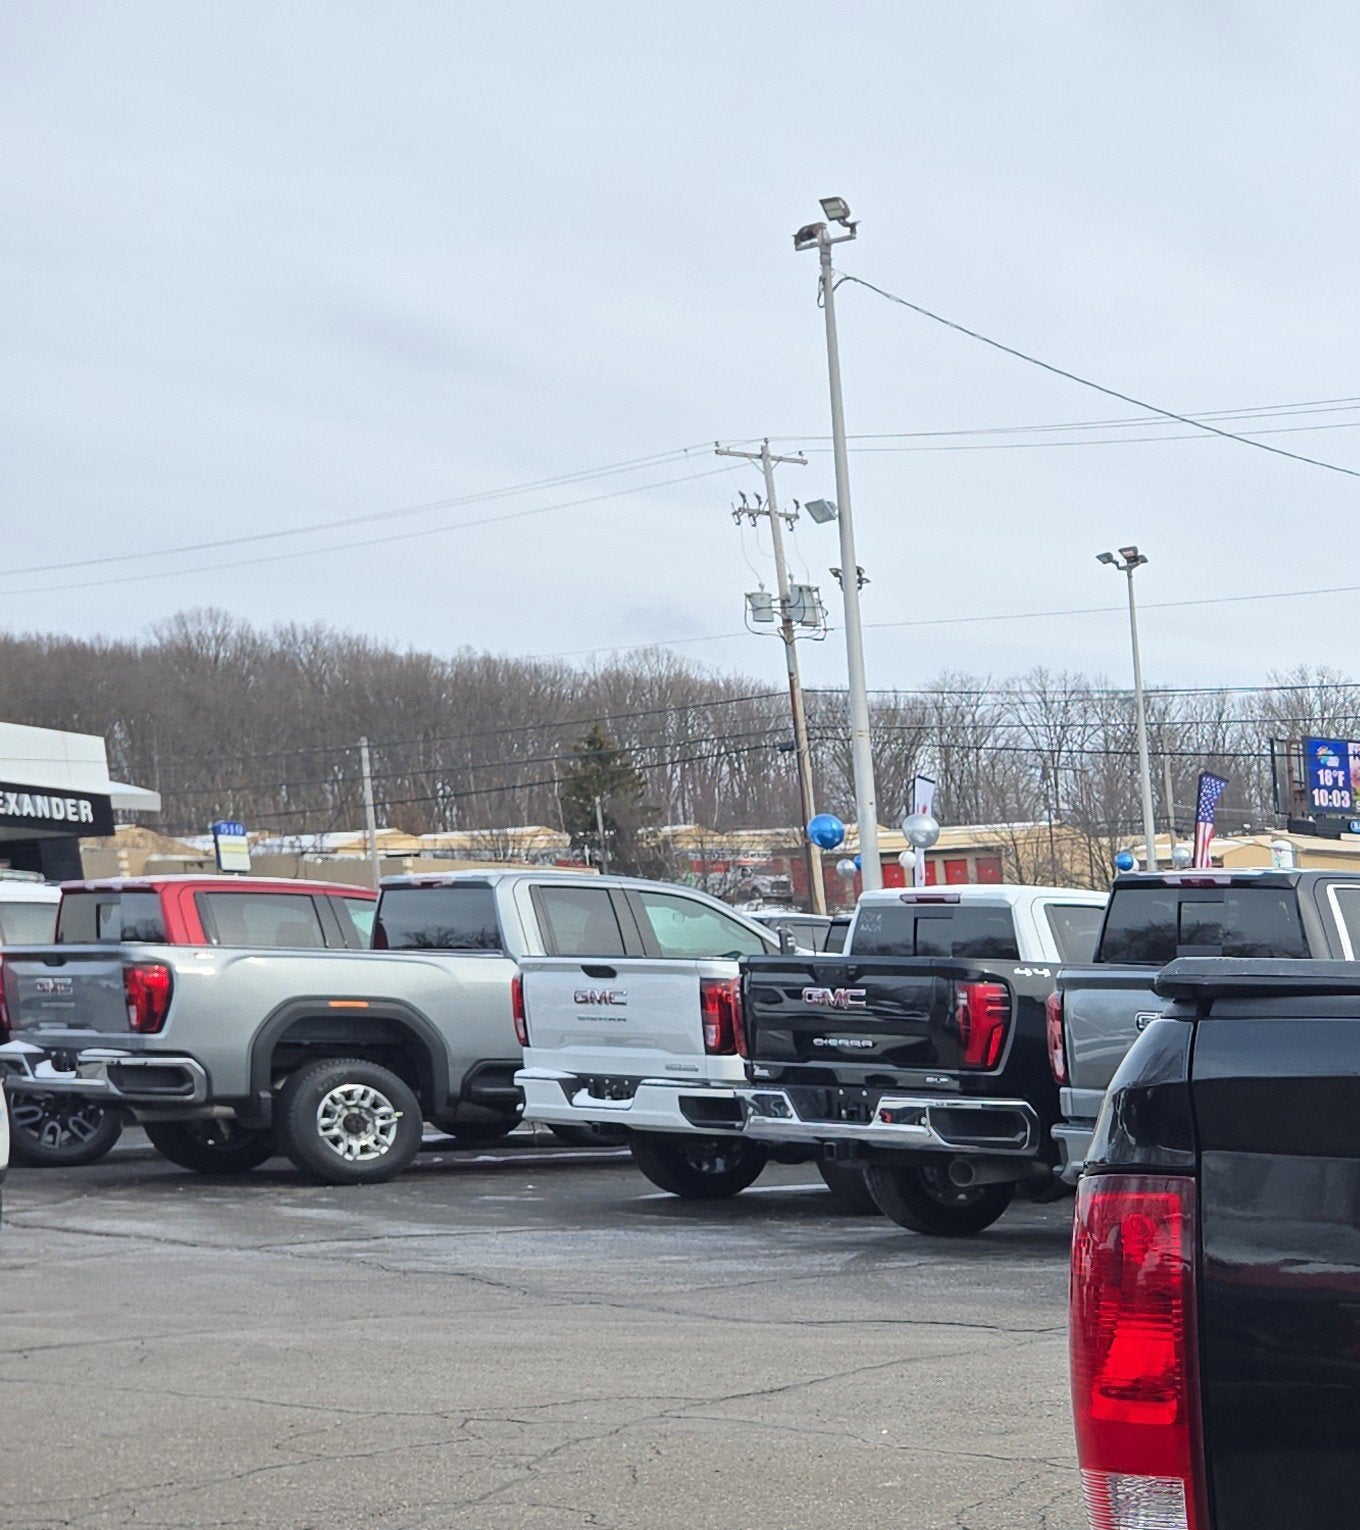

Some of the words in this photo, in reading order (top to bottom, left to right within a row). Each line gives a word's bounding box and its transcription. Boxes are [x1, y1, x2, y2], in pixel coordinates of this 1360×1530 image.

[1312, 788, 1351, 808] 10:03
[573, 989, 628, 1006] GMC
[802, 986, 867, 1009] GMC
